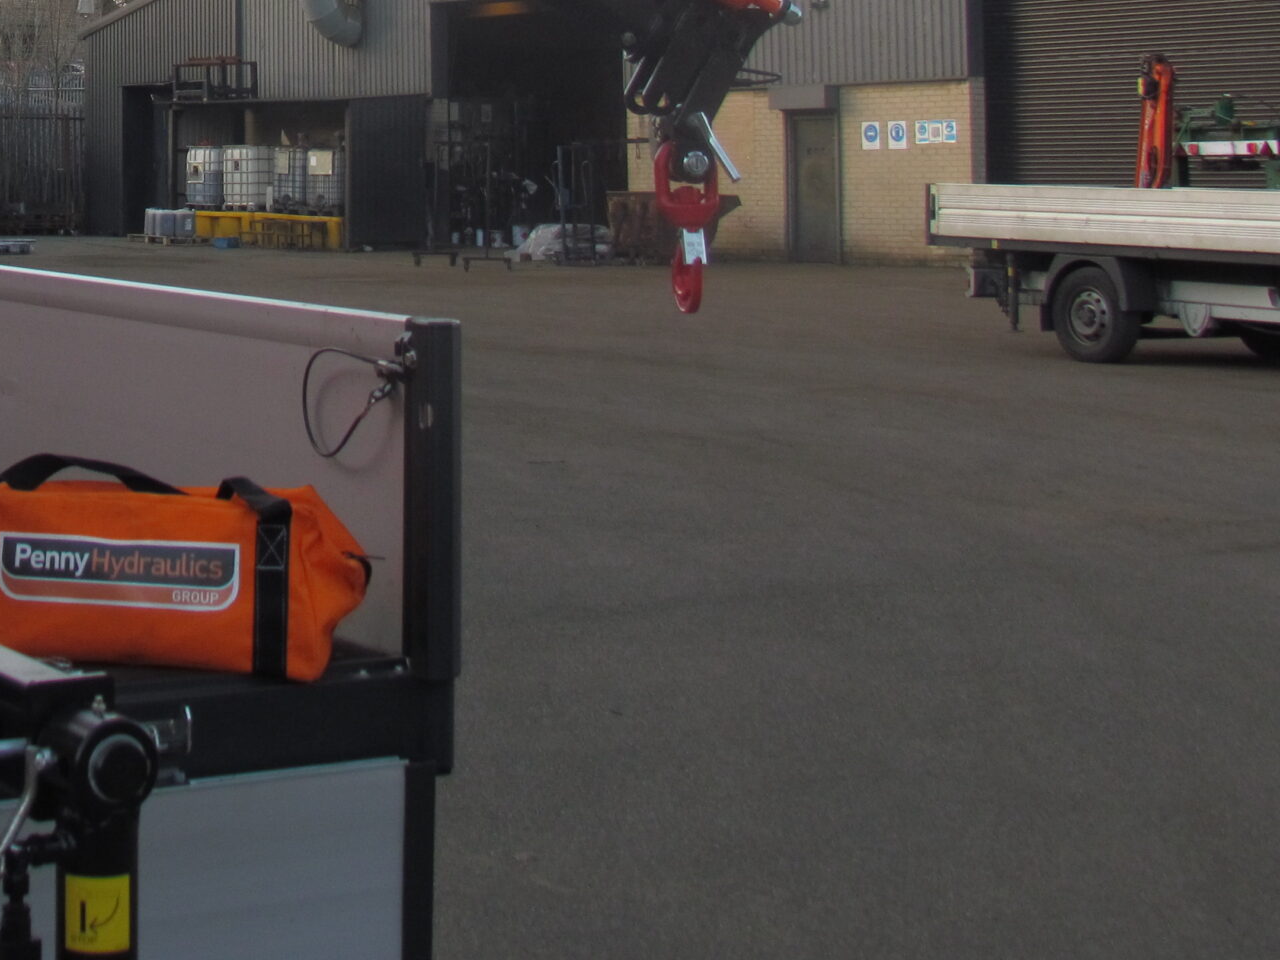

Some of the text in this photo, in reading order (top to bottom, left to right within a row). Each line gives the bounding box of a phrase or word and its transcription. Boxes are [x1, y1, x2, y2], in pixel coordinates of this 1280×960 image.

[14, 543, 223, 580] Penny Hydraulics
[171, 589, 220, 605] GROUP
